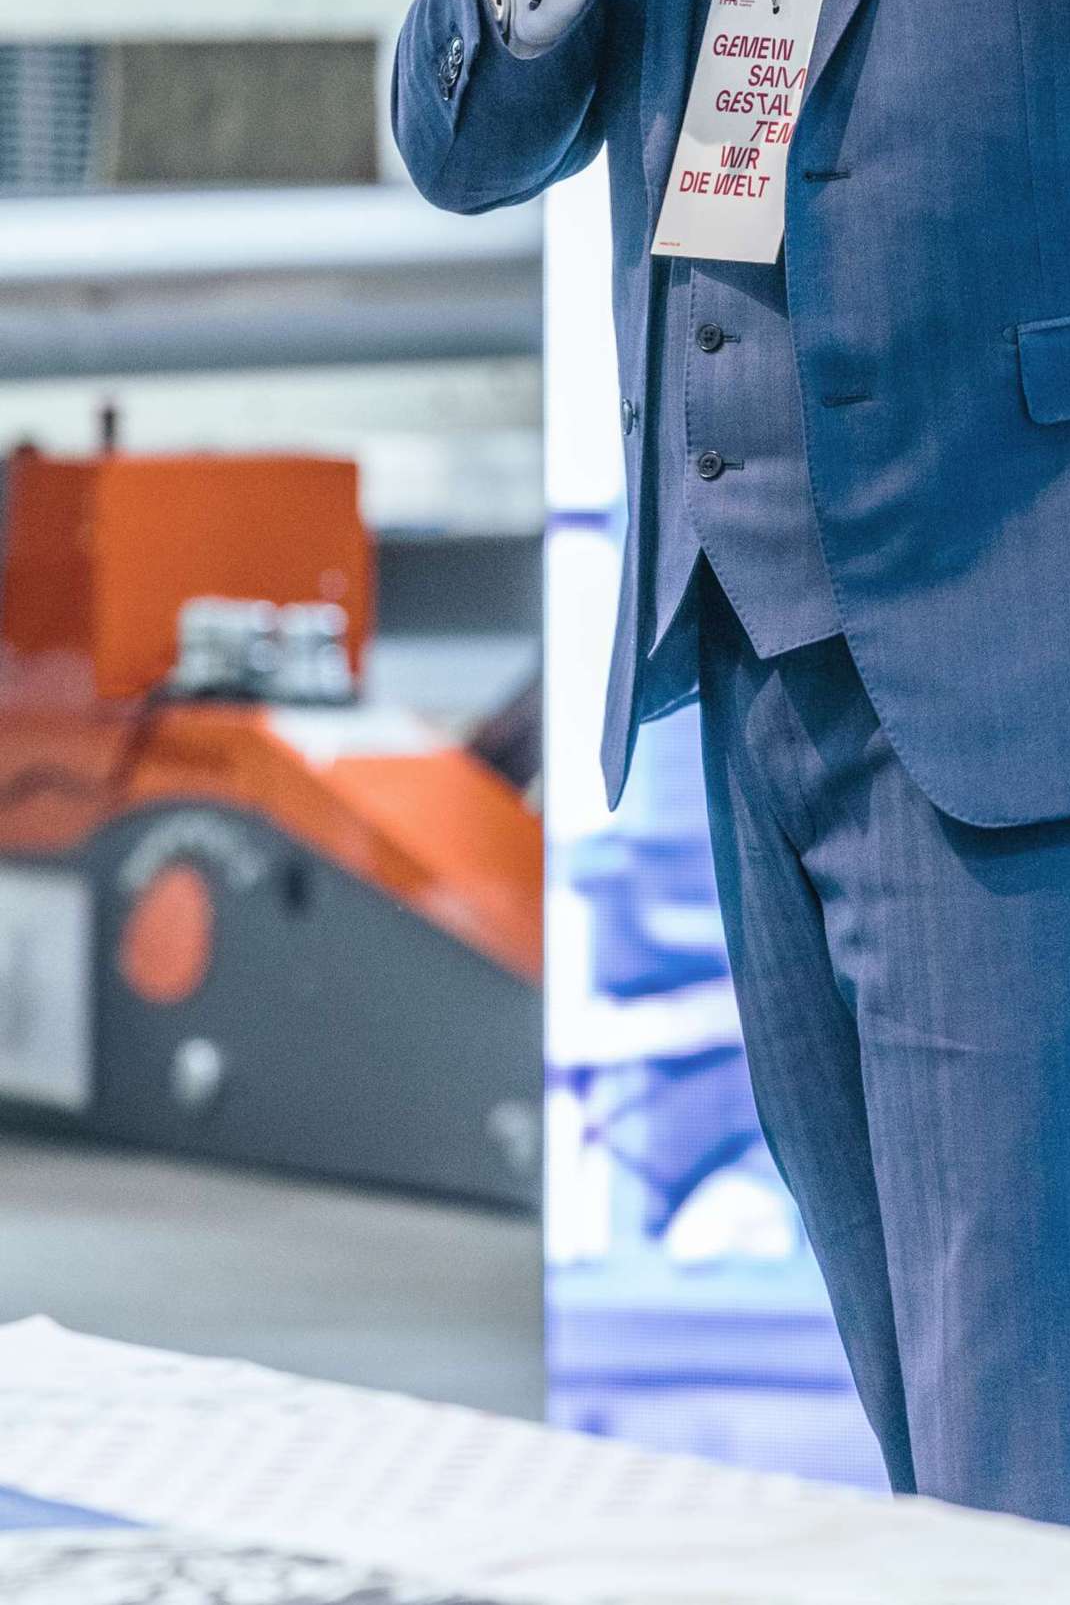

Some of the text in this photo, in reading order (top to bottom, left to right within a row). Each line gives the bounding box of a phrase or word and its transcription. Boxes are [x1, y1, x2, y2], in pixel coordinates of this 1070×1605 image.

[713, 34, 795, 61] GEMEIN
[748, 64, 807, 90] SAM
[715, 89, 793, 117] GESTAL
[750, 120, 795, 144] TEN
[720, 145, 760, 170] WIR
[679, 170, 771, 198] DIE WELT
